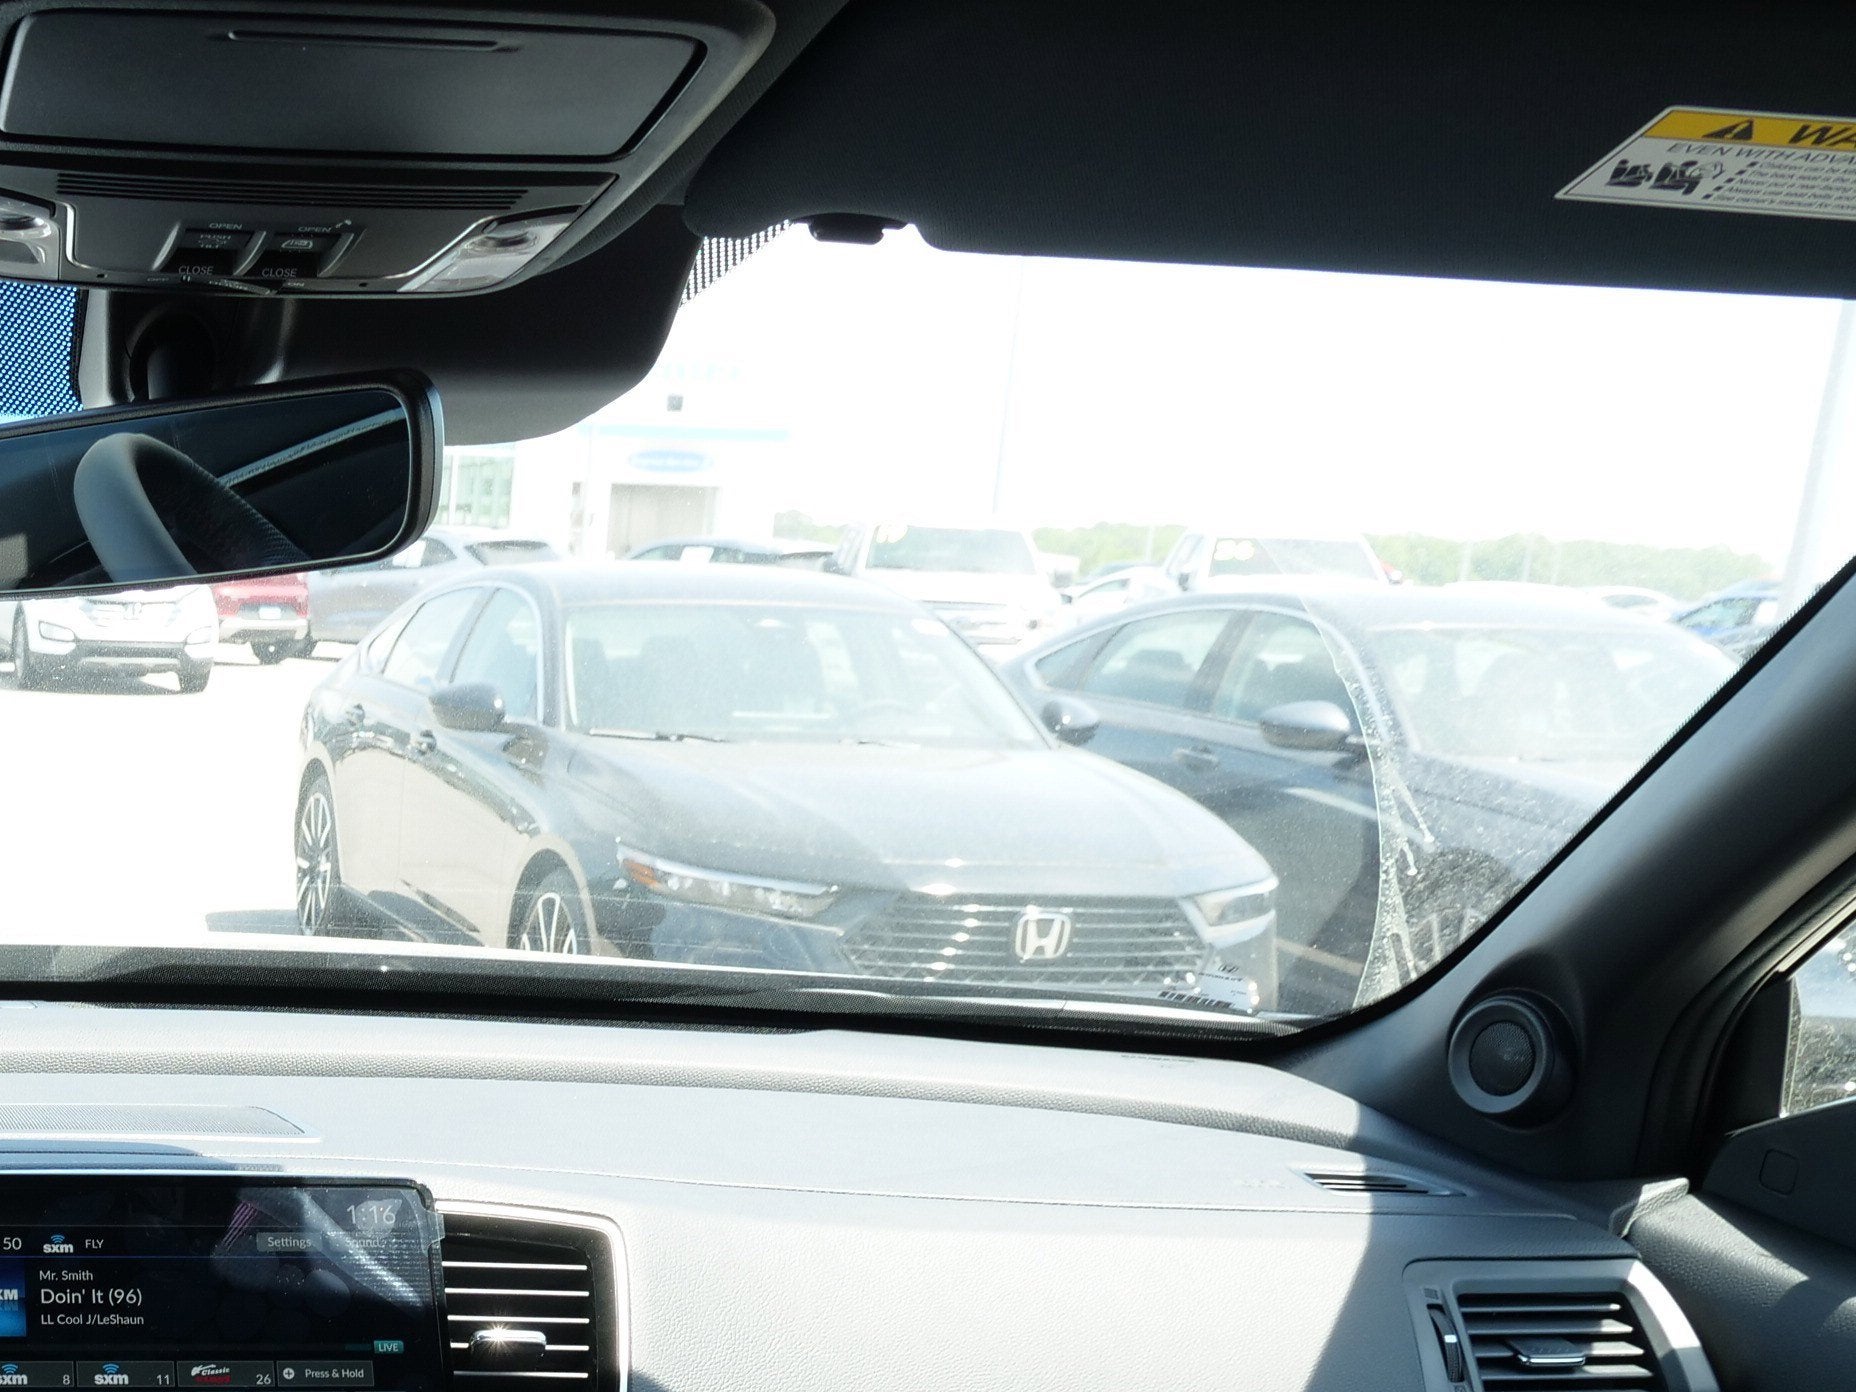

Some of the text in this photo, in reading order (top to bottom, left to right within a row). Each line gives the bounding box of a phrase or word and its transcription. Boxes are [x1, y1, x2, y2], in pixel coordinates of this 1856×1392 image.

[1667, 143, 1733, 154] EVEN
[1736, 148, 1796, 160] WITH
[209, 222, 243, 231] OPEN
[298, 225, 332, 233] OPEN
[179, 265, 214, 275] CLOSE
[262, 268, 297, 278] CLOSE
[346, 1203, 397, 1225] 1:16
[3, 1237, 22, 1251] 50
[43, 1242, 74, 1255] sxm
[85, 1239, 104, 1250] FLY
[267, 1236, 312, 1249] Settings
[39, 1270, 93, 1281] Mr. Smith
[40, 1288, 143, 1307] Doin' It (96)
[40, 1313, 145, 1327] LL Cool J/LeShaun
[378, 1343, 400, 1352] LIVE
[94, 1373, 129, 1386] sxm
[305, 1368, 364, 1379] Press & Hold
[62, 1374, 71, 1386] 8
[156, 1374, 171, 1386] 11
[256, 1374, 272, 1386] 26
